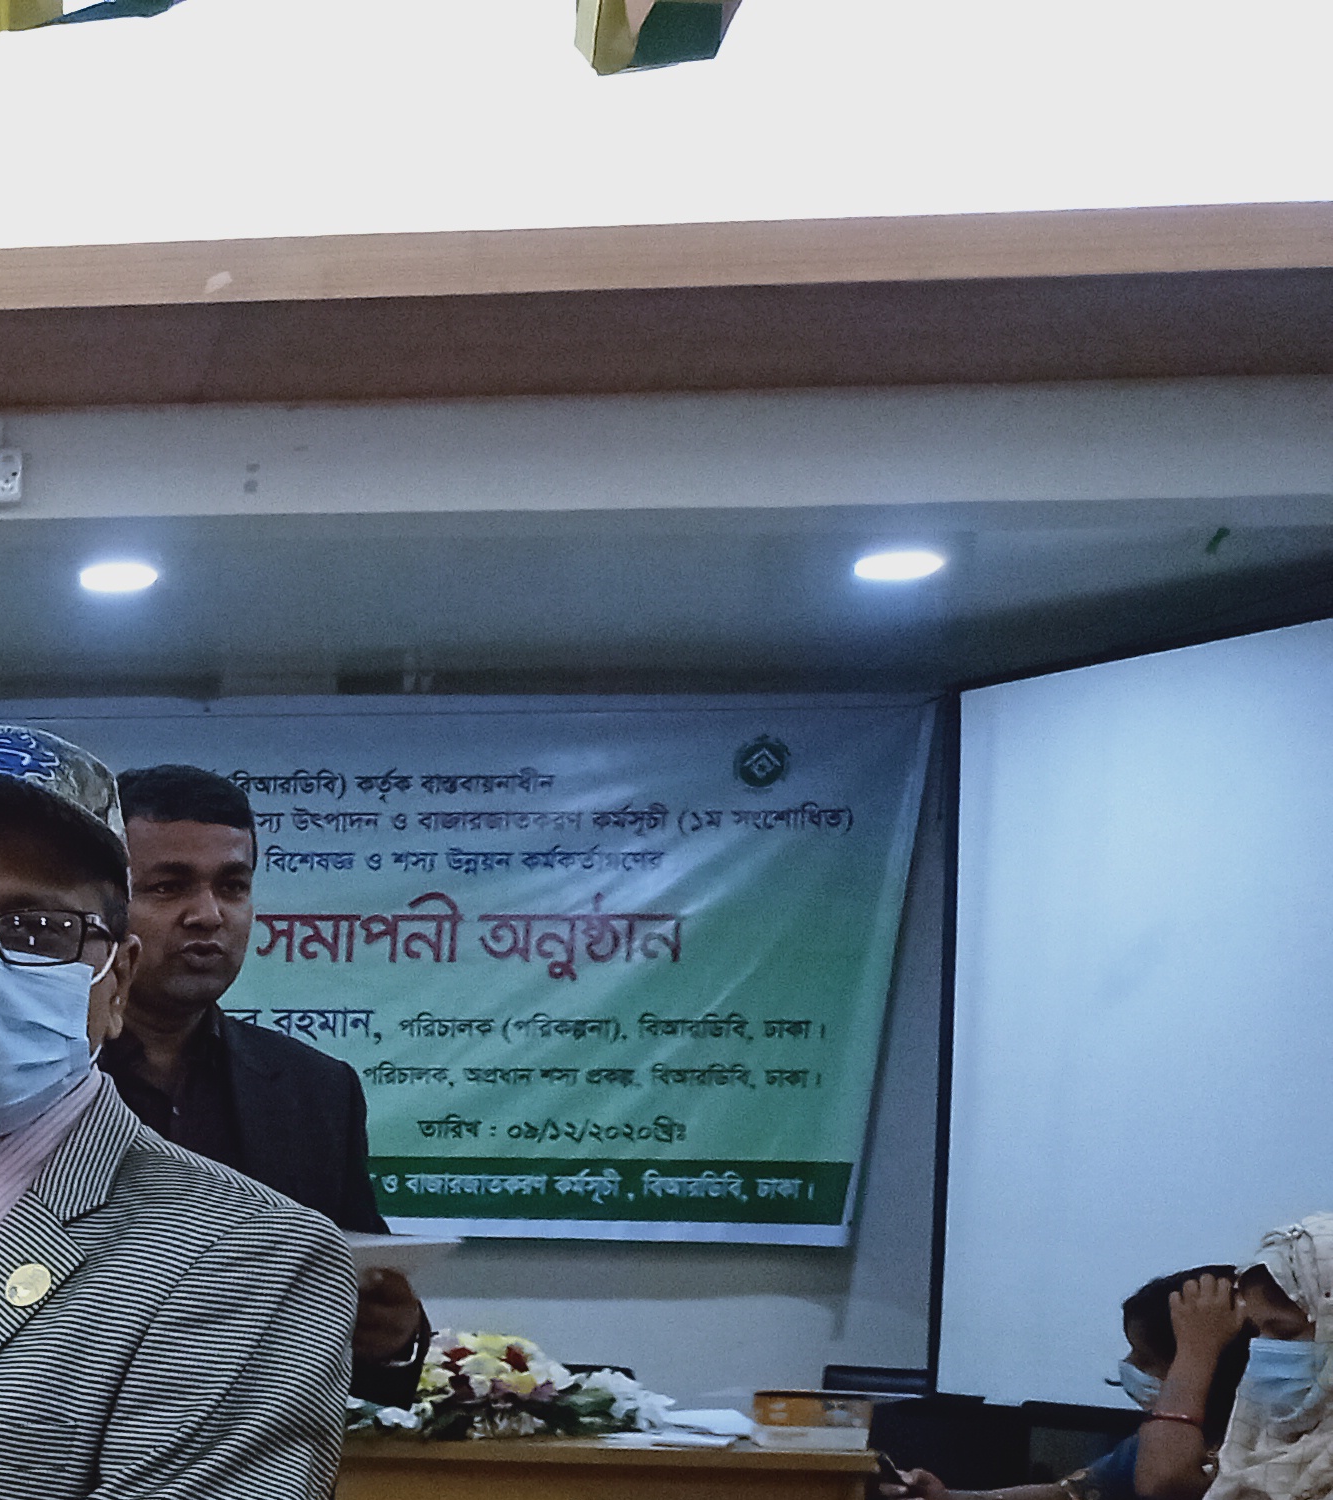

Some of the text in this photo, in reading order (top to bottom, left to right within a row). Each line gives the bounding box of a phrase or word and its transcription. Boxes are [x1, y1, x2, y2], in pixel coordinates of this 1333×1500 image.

[230, 767, 555, 803] বিআরডিবি) কর্তৃক বাস্তবায়নাধীন
[290, 806, 383, 834] উৎপাদন
[390, 813, 409, 831] ও
[417, 811, 584, 834] বাজারজাতকরণ
[676, 808, 724, 836] (১ম
[730, 801, 855, 836] সংশোধিত)
[264, 845, 355, 873] বিশেষজ্ঞ
[365, 853, 383, 872] ও
[391, 851, 438, 873] শস্য
[445, 847, 515, 876] উন্নয়ন
[254, 891, 464, 963] সমাপনী
[478, 891, 682, 982] অনুষ্ঠান
[398, 1011, 495, 1039] পরিচালক
[501, 1012, 628, 1043] (পরিকল্পনা),
[637, 1011, 755, 1041] বিআরডিবি,
[416, 1112, 483, 1140] তারিখ
[382, 1173, 399, 1196] ও
[405, 1172, 548, 1196] বাজারজাতকরণ
